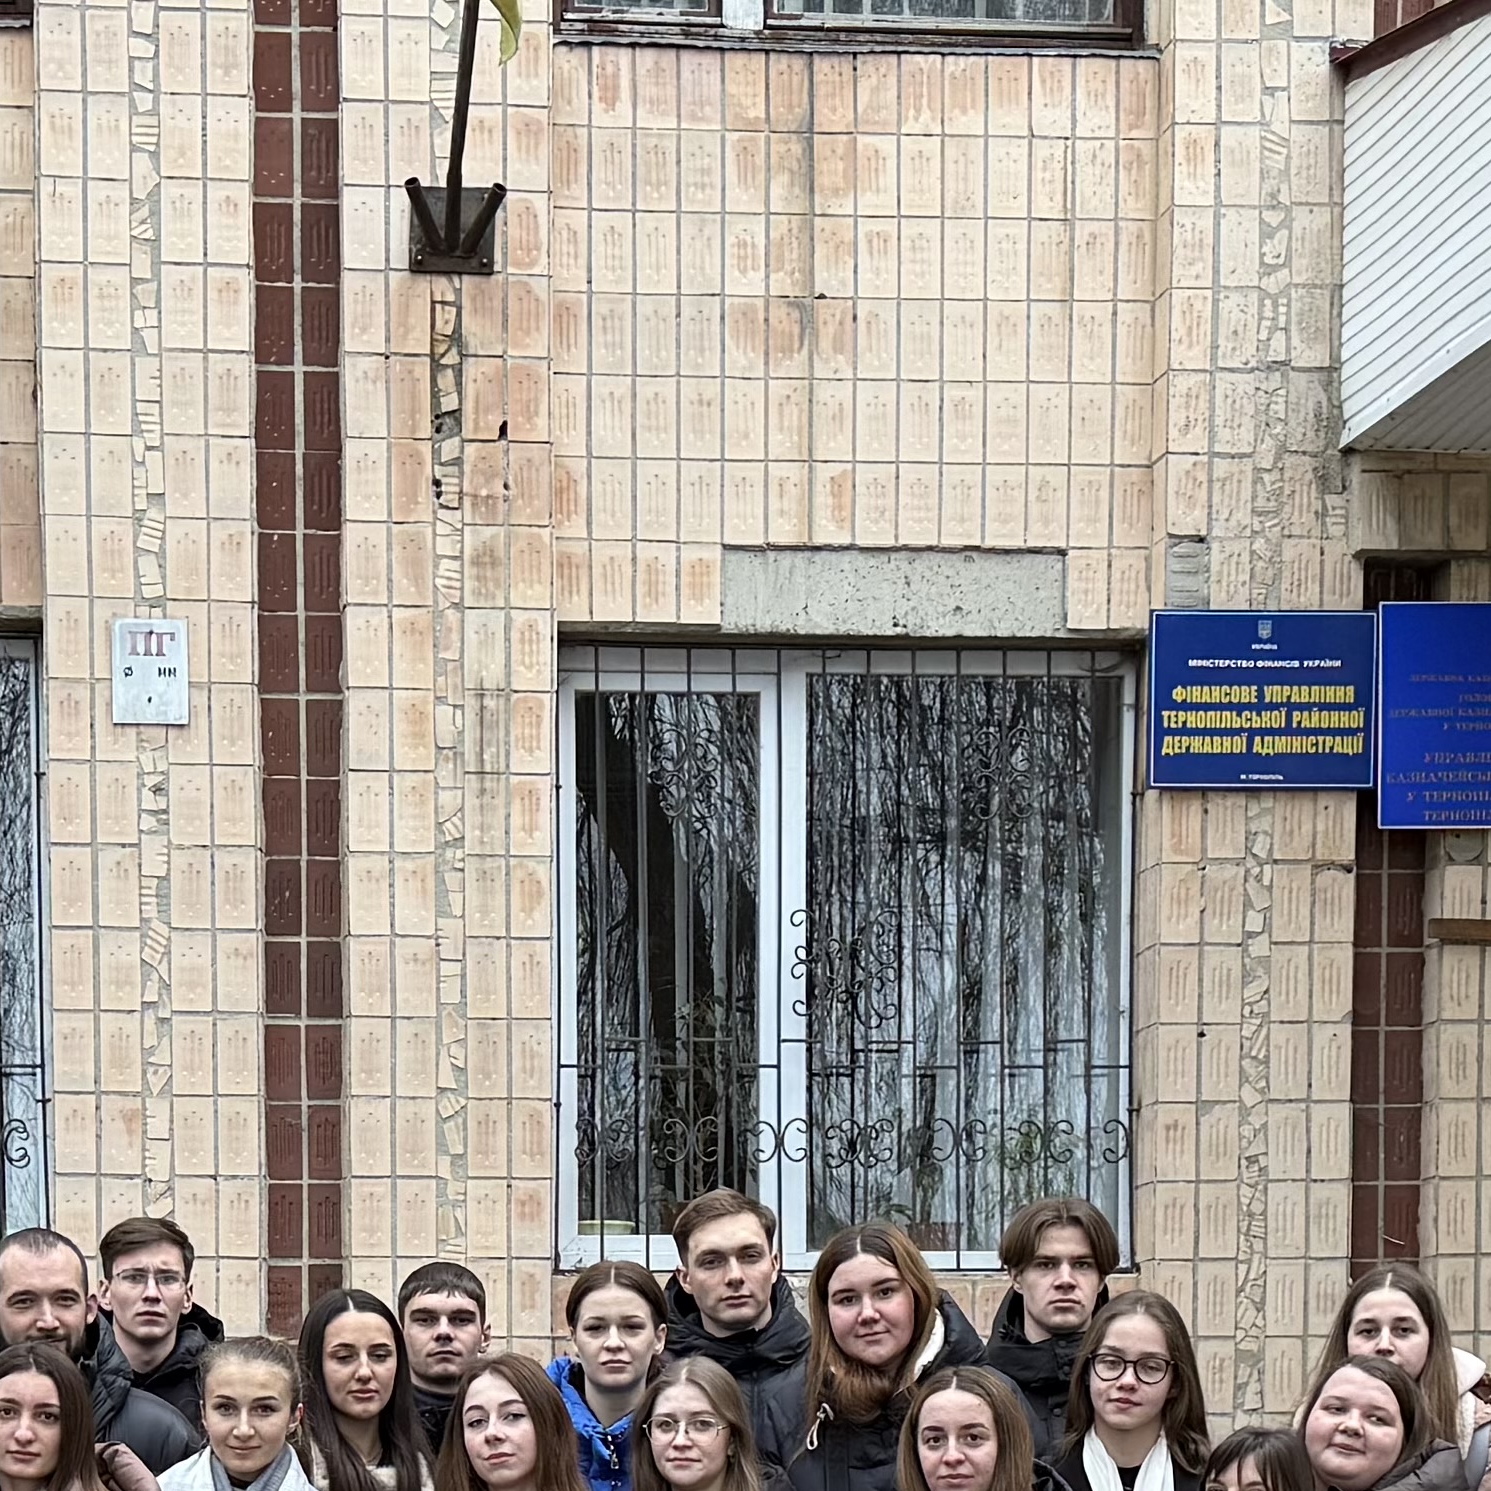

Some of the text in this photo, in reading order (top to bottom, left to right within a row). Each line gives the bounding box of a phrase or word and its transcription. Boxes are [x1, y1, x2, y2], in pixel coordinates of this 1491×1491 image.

[1172, 685, 1355, 703] ФІНАНСОВЕ УПРАВЛІННЯ
[1161, 707, 1365, 728] ТЕРНОПІЛЬСЬКОЇ РАЙОННОЇ
[1161, 733, 1365, 756] ДЕРЖАВНОЇ АДМІНІСТРАЦІЇ
